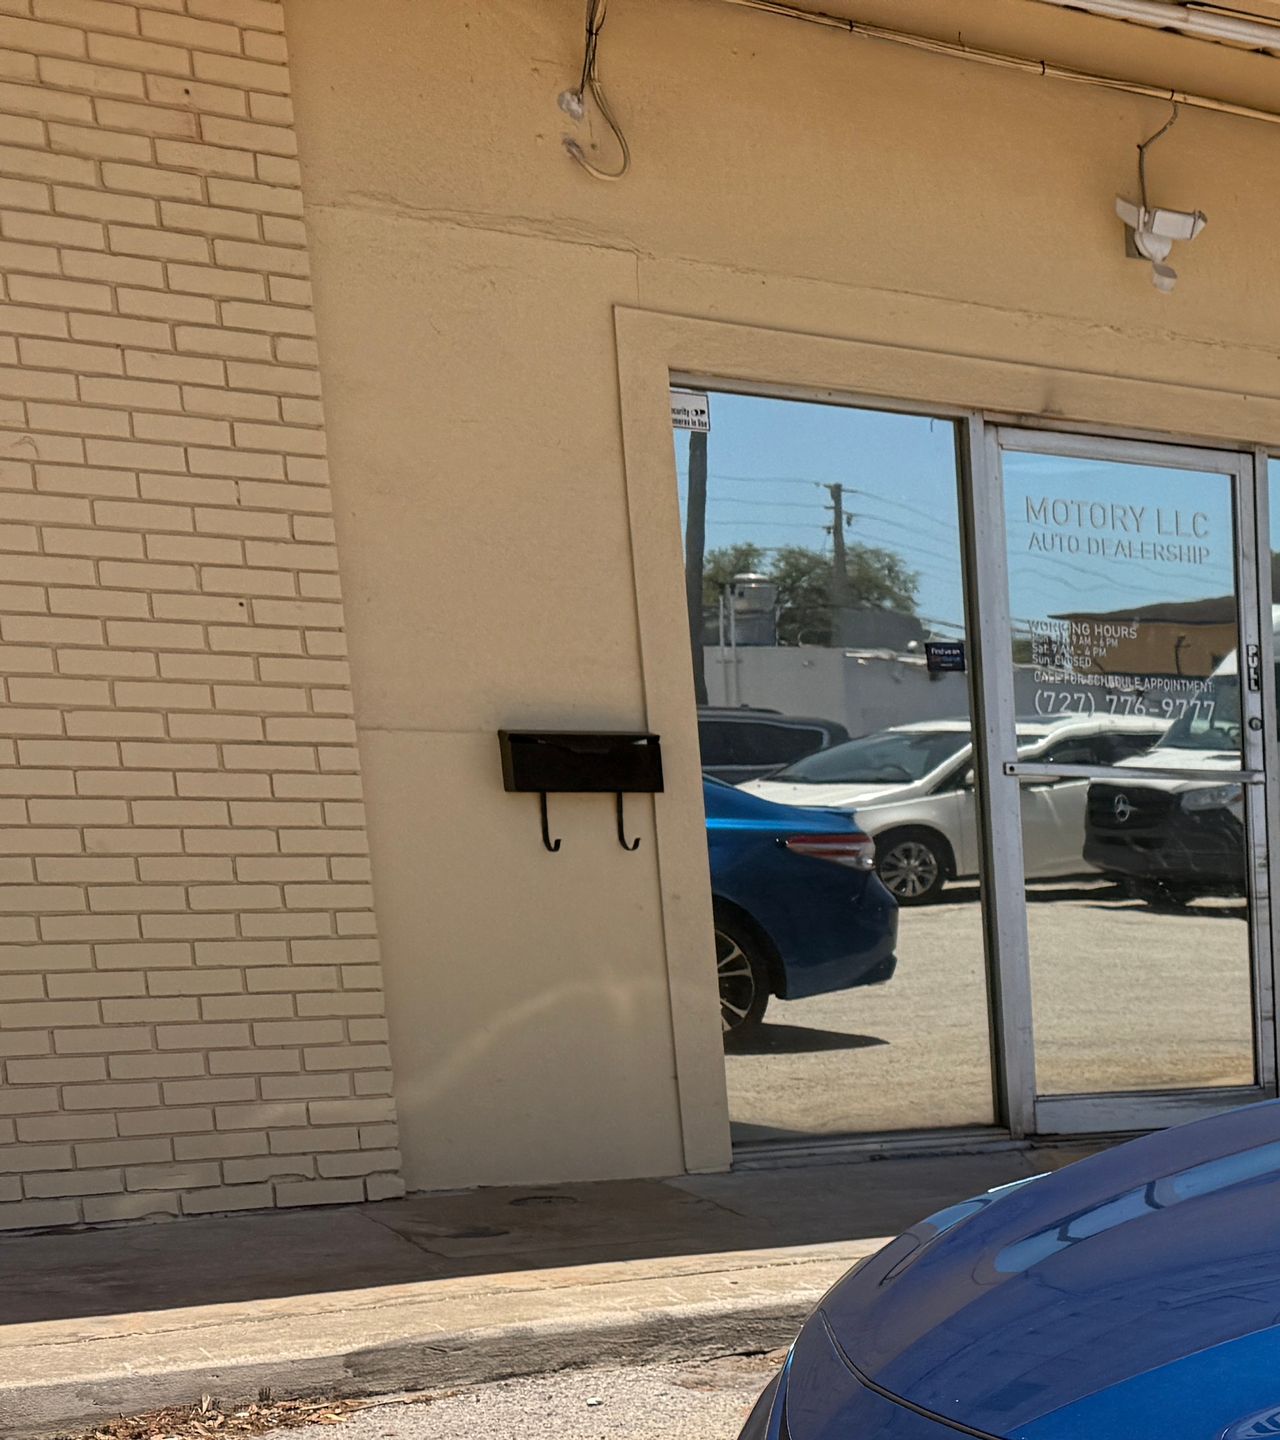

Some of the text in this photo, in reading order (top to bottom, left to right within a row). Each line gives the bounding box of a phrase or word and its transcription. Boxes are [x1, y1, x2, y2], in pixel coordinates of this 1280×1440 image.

[1025, 495, 1210, 539] MOTORY LLC
[1028, 531, 1211, 565] AUTO DEALERSHIP
[1078, 635, 1092, 646] AM
[1106, 638, 1119, 648] PM
[1094, 623, 1138, 640] HOURS
[1054, 655, 1092, 668] CLOSED
[1092, 647, 1107, 657] PM
[1248, 645, 1261, 691] PULL
[1034, 689, 1216, 723] (727) 776-9777
